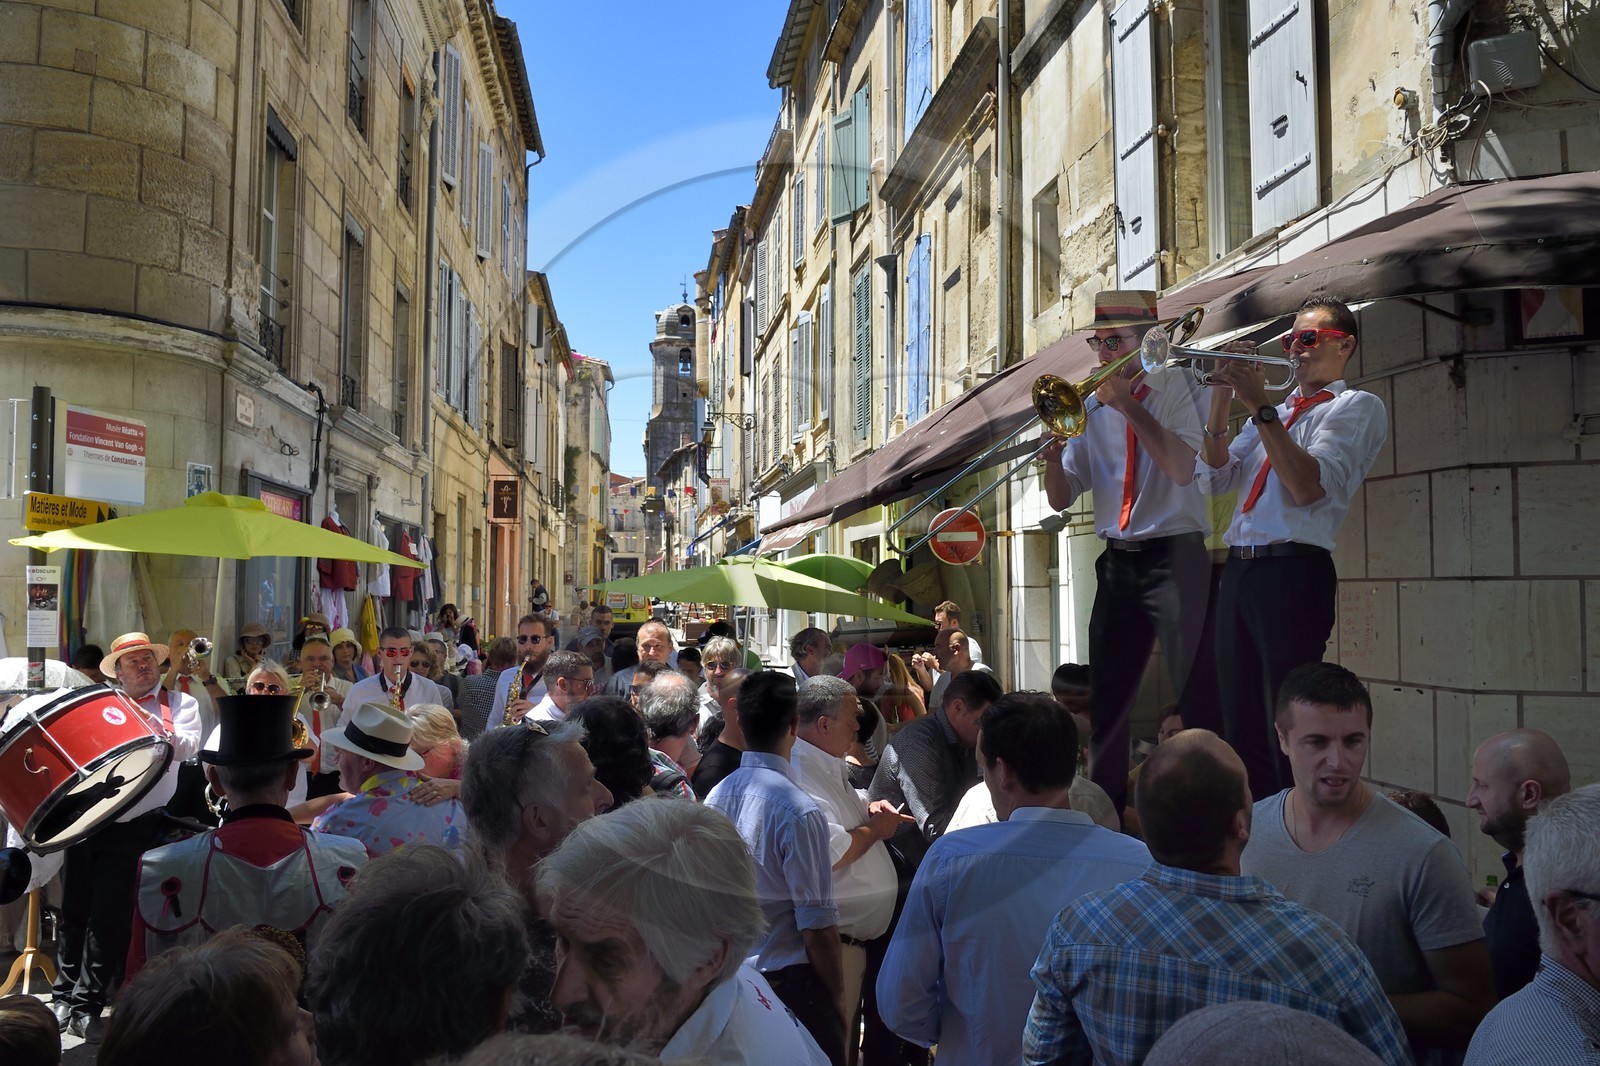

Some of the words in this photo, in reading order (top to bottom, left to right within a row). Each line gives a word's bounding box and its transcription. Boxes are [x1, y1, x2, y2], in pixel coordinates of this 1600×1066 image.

[106, 423, 121, 432] Musée
[121, 426, 138, 436] Réattu
[69, 432, 94, 443] Fondation
[95, 436, 114, 447] Vincent
[115, 440, 125, 449] Van
[125, 442, 138, 452] Gogh
[83, 450, 104, 461] Thermes
[105, 454, 111, 462] de
[111, 455, 138, 466] Constantin
[30, 496, 60, 516] Matières
[61, 501, 68, 516] et
[69, 501, 88, 519] Mode
